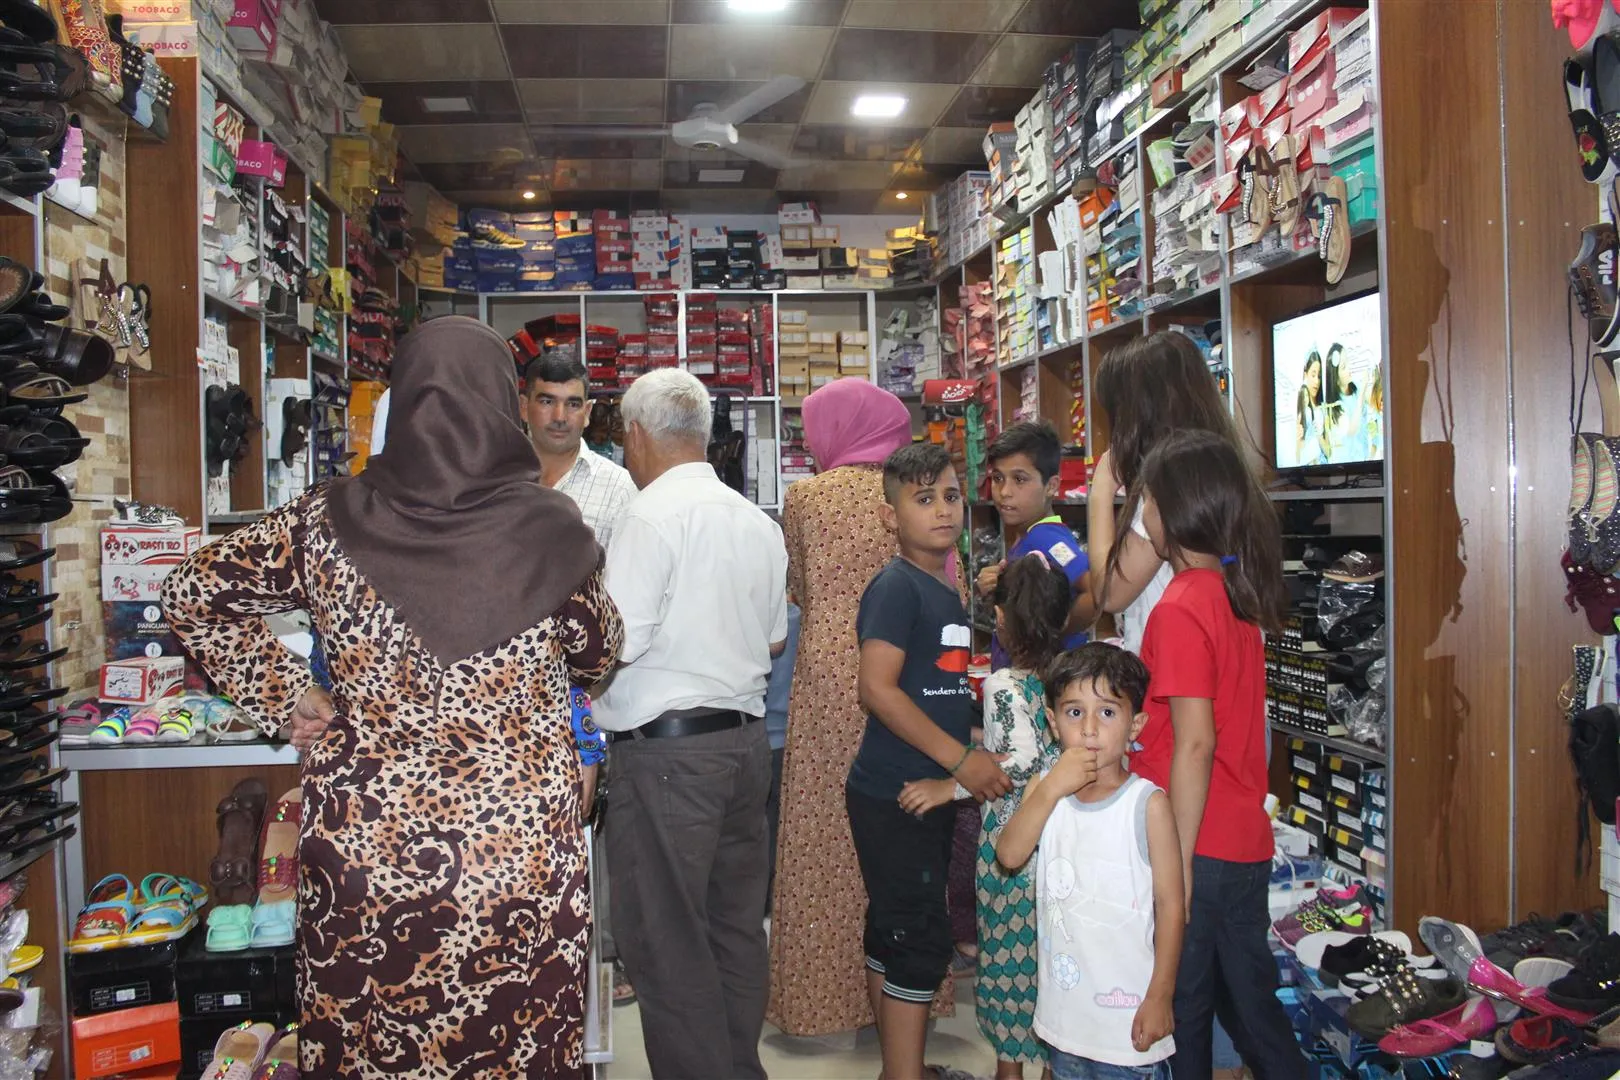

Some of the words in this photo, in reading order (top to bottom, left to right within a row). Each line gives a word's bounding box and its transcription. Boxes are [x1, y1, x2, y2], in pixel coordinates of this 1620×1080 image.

[132, 6, 181, 14] TOOBACO
[1598, 249, 1613, 285] FILA
[922, 686, 957, 696] Sendero
